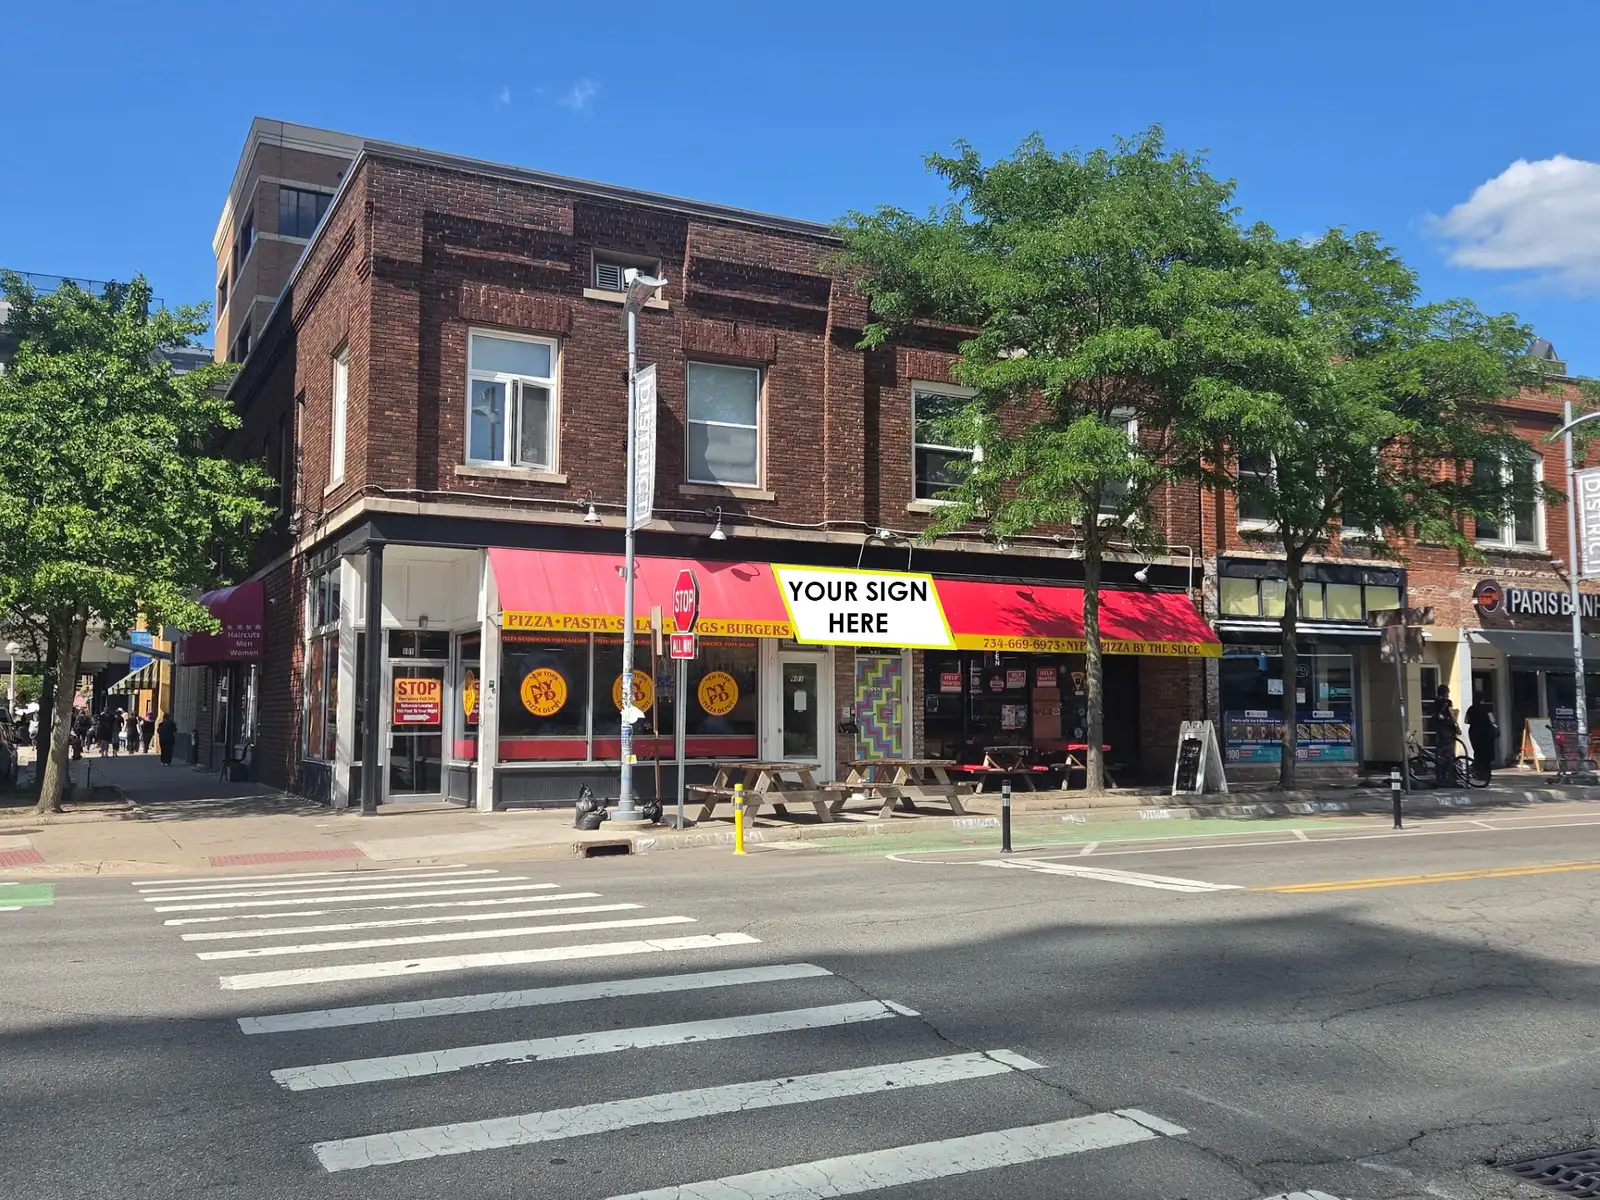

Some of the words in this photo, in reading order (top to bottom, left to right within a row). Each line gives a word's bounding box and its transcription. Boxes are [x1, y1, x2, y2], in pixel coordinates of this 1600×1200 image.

[674, 590, 694, 613] STOP
[1512, 590, 1558, 615] PARIS
[508, 614, 553, 627] PIZZA
[563, 616, 608, 629] PASTA
[727, 623, 790, 636] BURGERS
[672, 640, 682, 654] ALL
[983, 638, 1060, 650] 734-669-6973
[1101, 642, 1130, 652] PIZZA
[1133, 643, 1146, 652] BY
[1148, 644, 1168, 653] THE
[1171, 644, 1200, 654] SLICE
[398, 681, 437, 695] STOP
[533, 690, 556, 704] PD
[708, 691, 729, 705] PD
